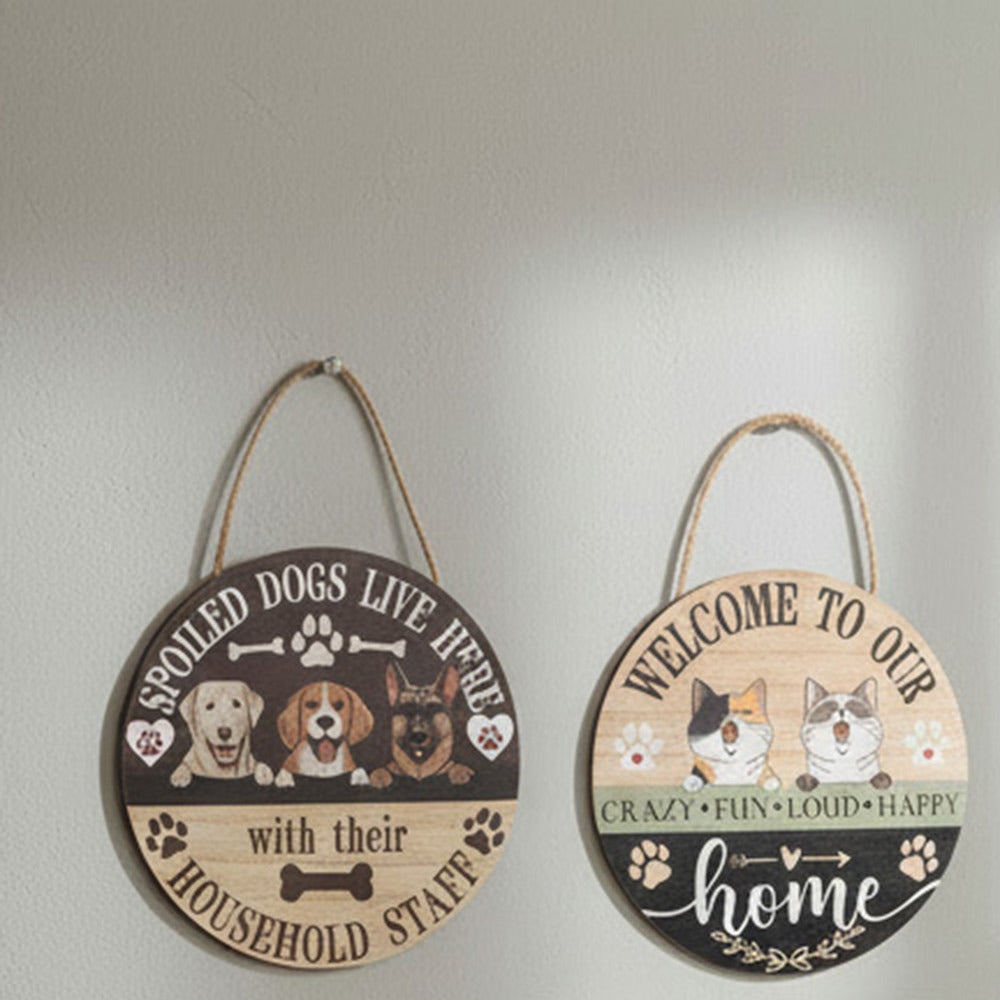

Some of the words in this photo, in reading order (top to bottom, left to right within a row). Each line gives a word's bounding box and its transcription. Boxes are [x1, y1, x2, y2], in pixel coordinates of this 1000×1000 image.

[138, 585, 250, 715] SPOILED
[255, 562, 347, 610] DOGS
[360, 568, 437, 633] LIVE
[622, 581, 799, 701] WELCOME
[816, 586, 866, 640] TO
[871, 625, 937, 705] OUR
[248, 816, 315, 855] with
[334, 814, 408, 854] their
[600, 797, 696, 824] CRAZY
[714, 796, 770, 821] FUN
[787, 794, 861, 820] LOUD
[877, 791, 961, 818] HAPPY
[166, 856, 370, 964] HOUSEHOLD
[382, 849, 479, 947] STAFF
[642, 836, 942, 937] home
